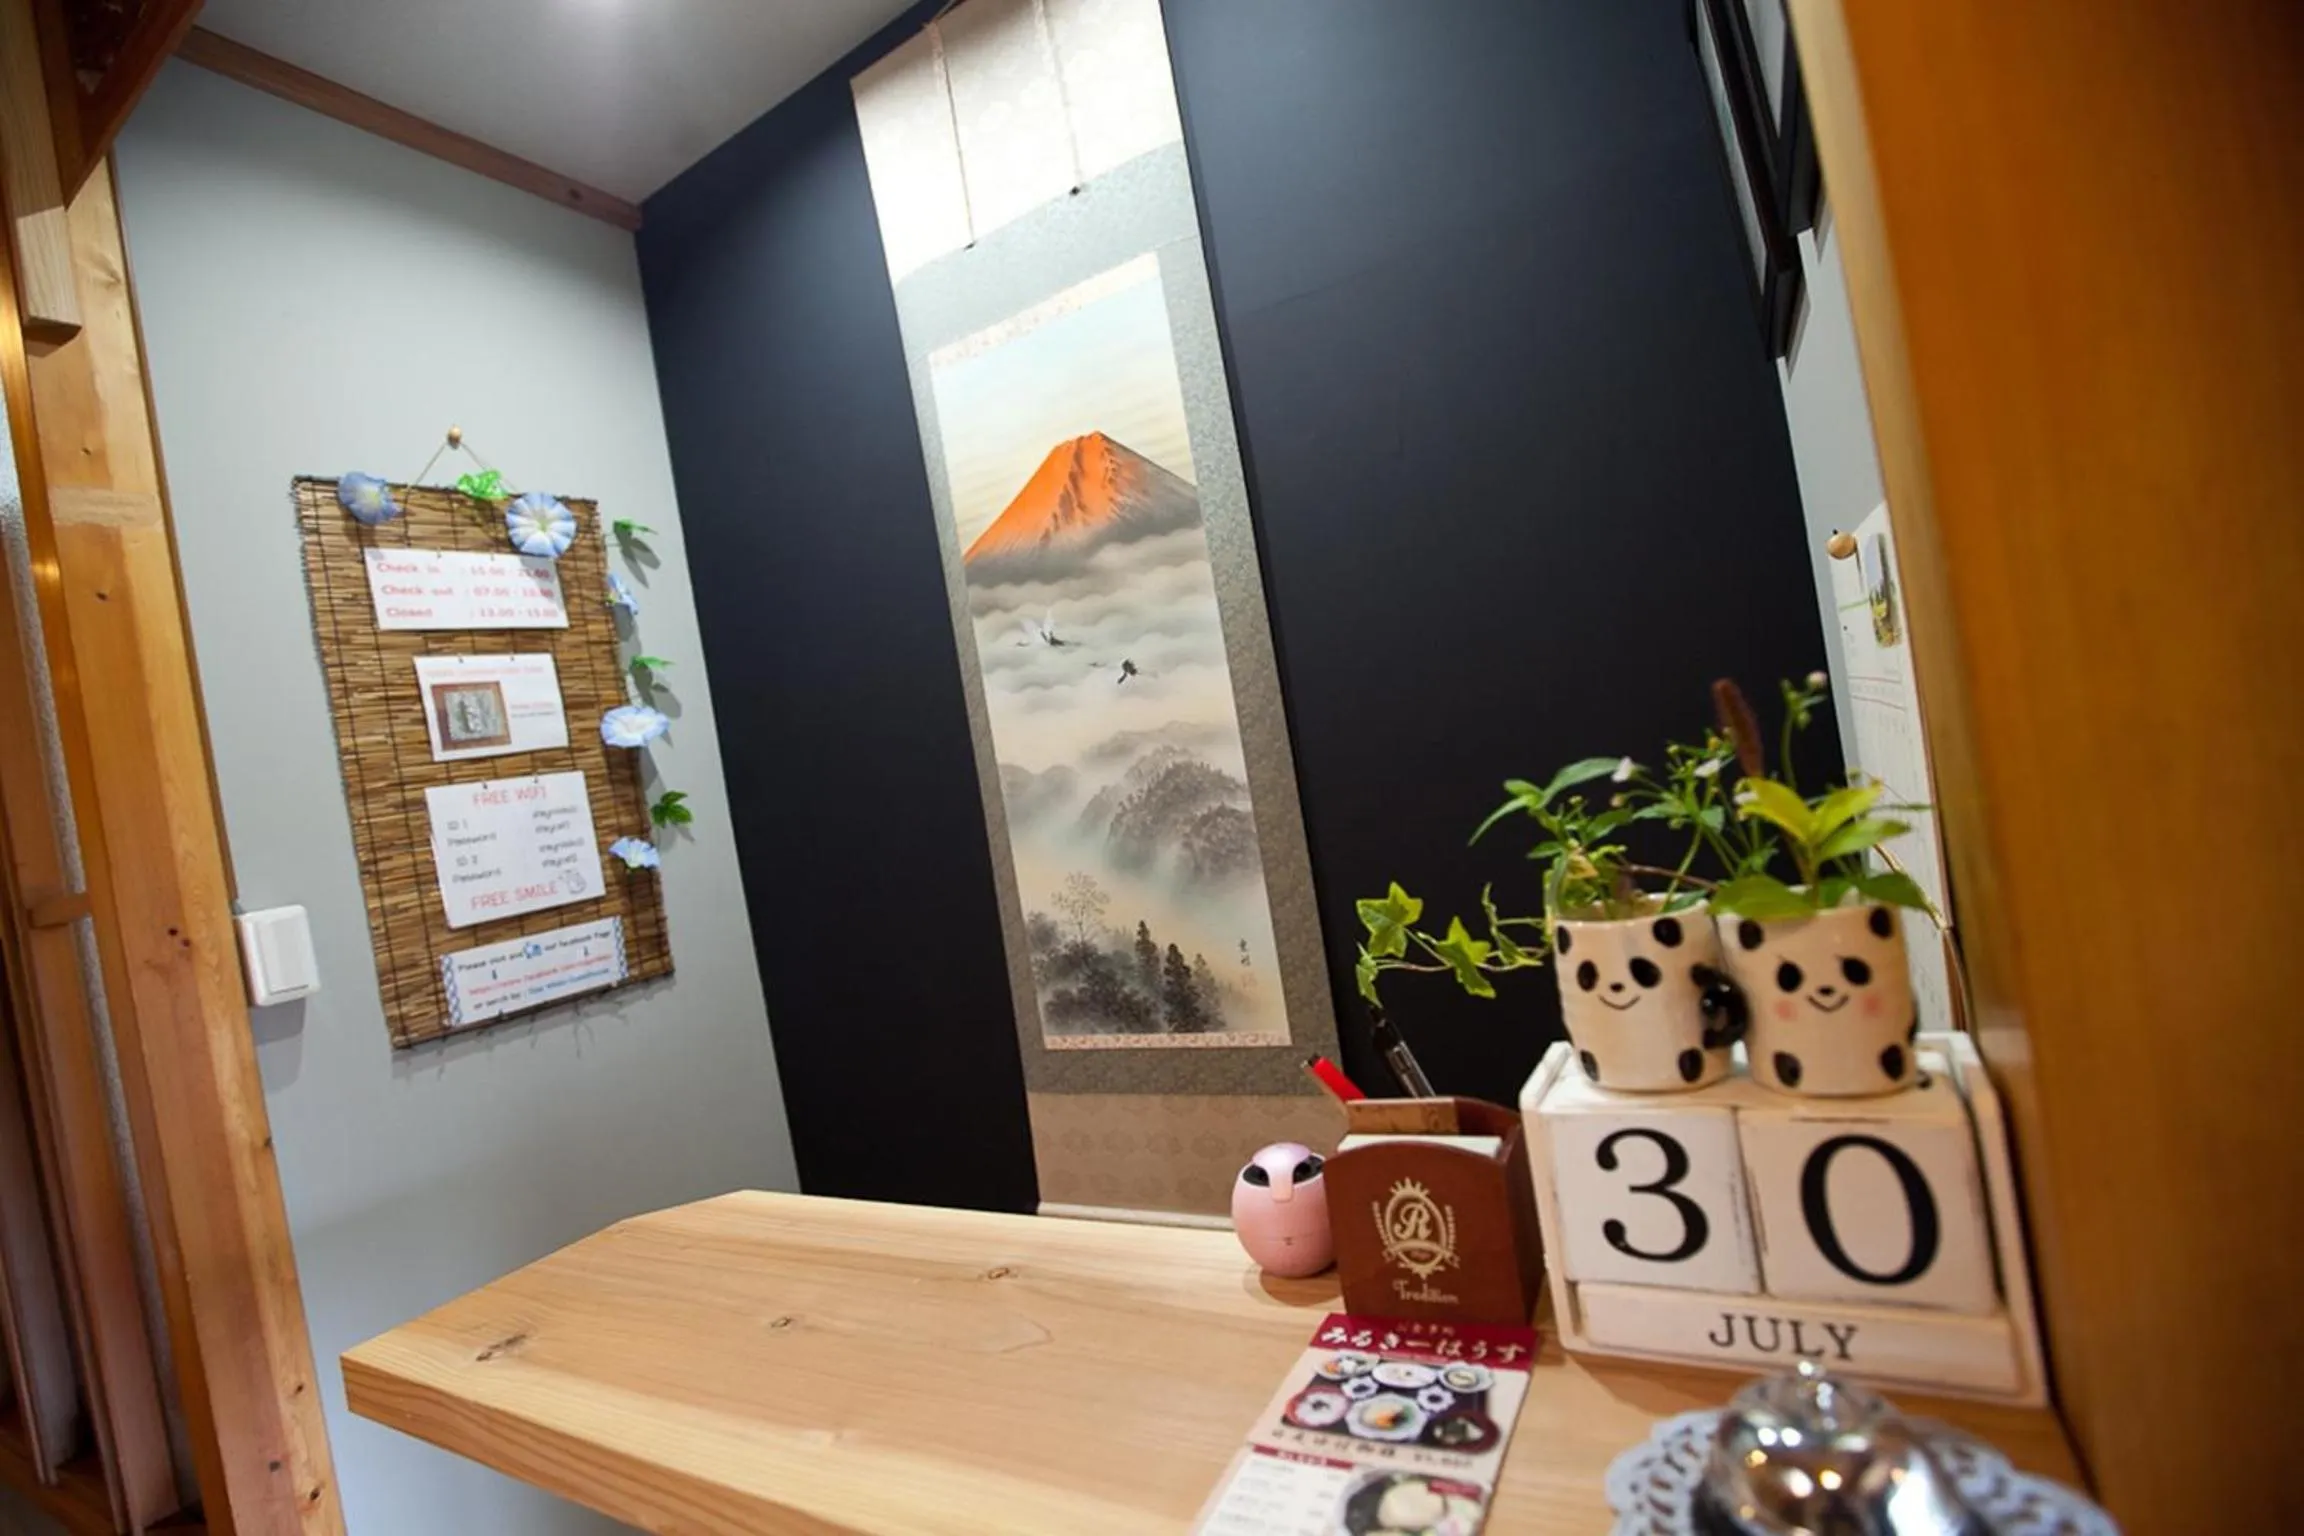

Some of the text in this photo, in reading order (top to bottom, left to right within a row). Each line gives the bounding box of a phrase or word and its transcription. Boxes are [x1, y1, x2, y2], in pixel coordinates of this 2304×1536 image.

[376, 562, 418, 573] Check
[381, 585, 423, 596] Check
[472, 789, 509, 806] FREE
[471, 881, 559, 910] FREE SMILE
[1392, 1279, 1460, 1304] Tradition
[1321, 1326, 1527, 1363] みるきーはうす
[1709, 1313, 1860, 1361] JULY
